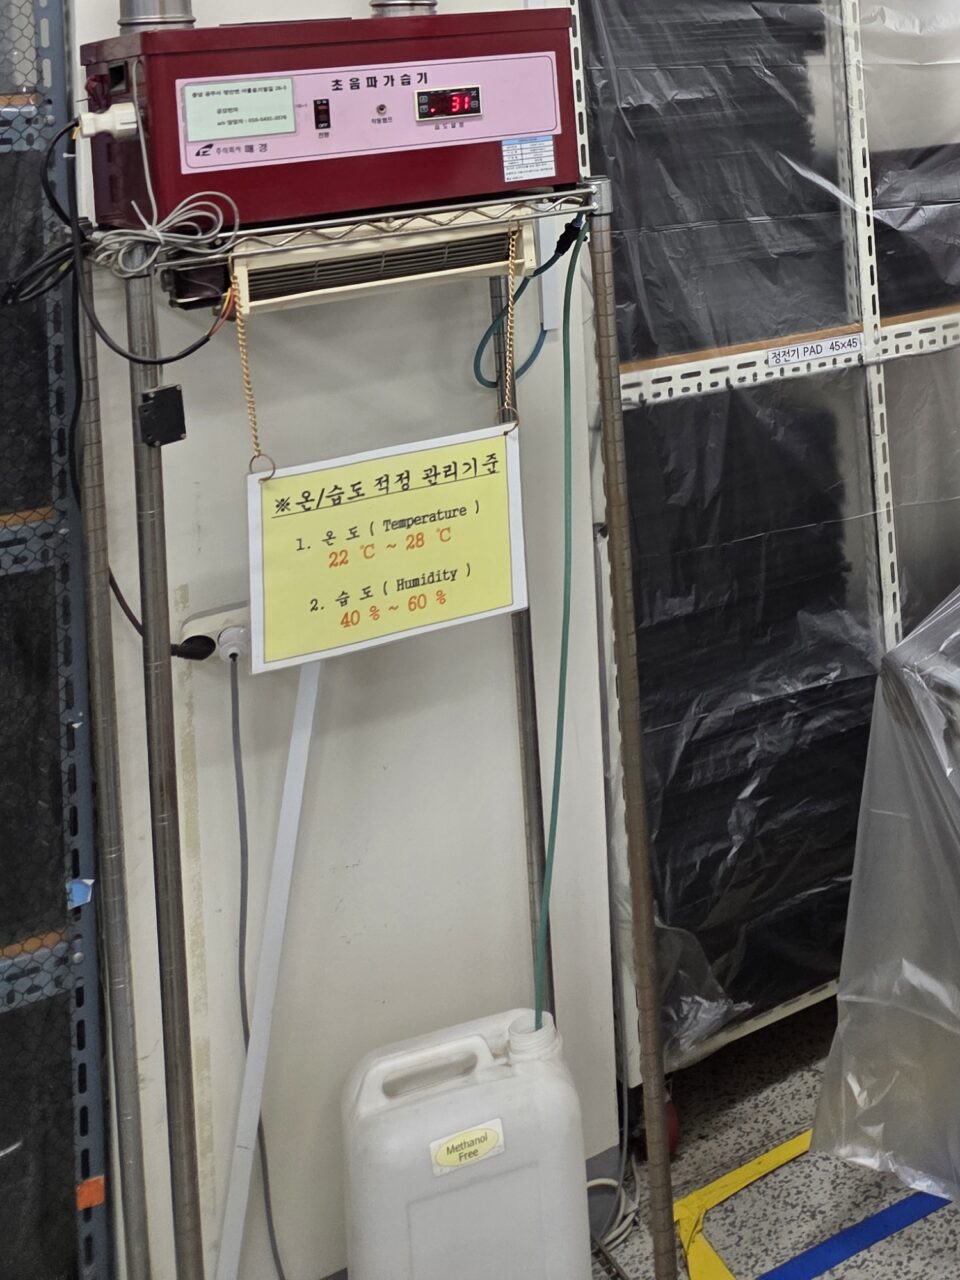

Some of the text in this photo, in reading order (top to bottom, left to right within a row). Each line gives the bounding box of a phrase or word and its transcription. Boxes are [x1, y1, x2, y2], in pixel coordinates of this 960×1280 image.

[451, 96, 470, 112] 31
[771, 347, 800, 364] 정전기
[803, 344, 823, 357] PAD
[374, 470, 411, 494] 적정
[421, 453, 500, 487] 관리기준
[296, 537, 311, 552] 1.
[329, 549, 349, 569] 22
[405, 532, 425, 551] 28
[310, 598, 325, 613] 2.
[340, 610, 360, 628] 40
[408, 593, 427, 612] 60
[446, 1131, 488, 1156] Methanol
[458, 1149, 479, 1162] Free
